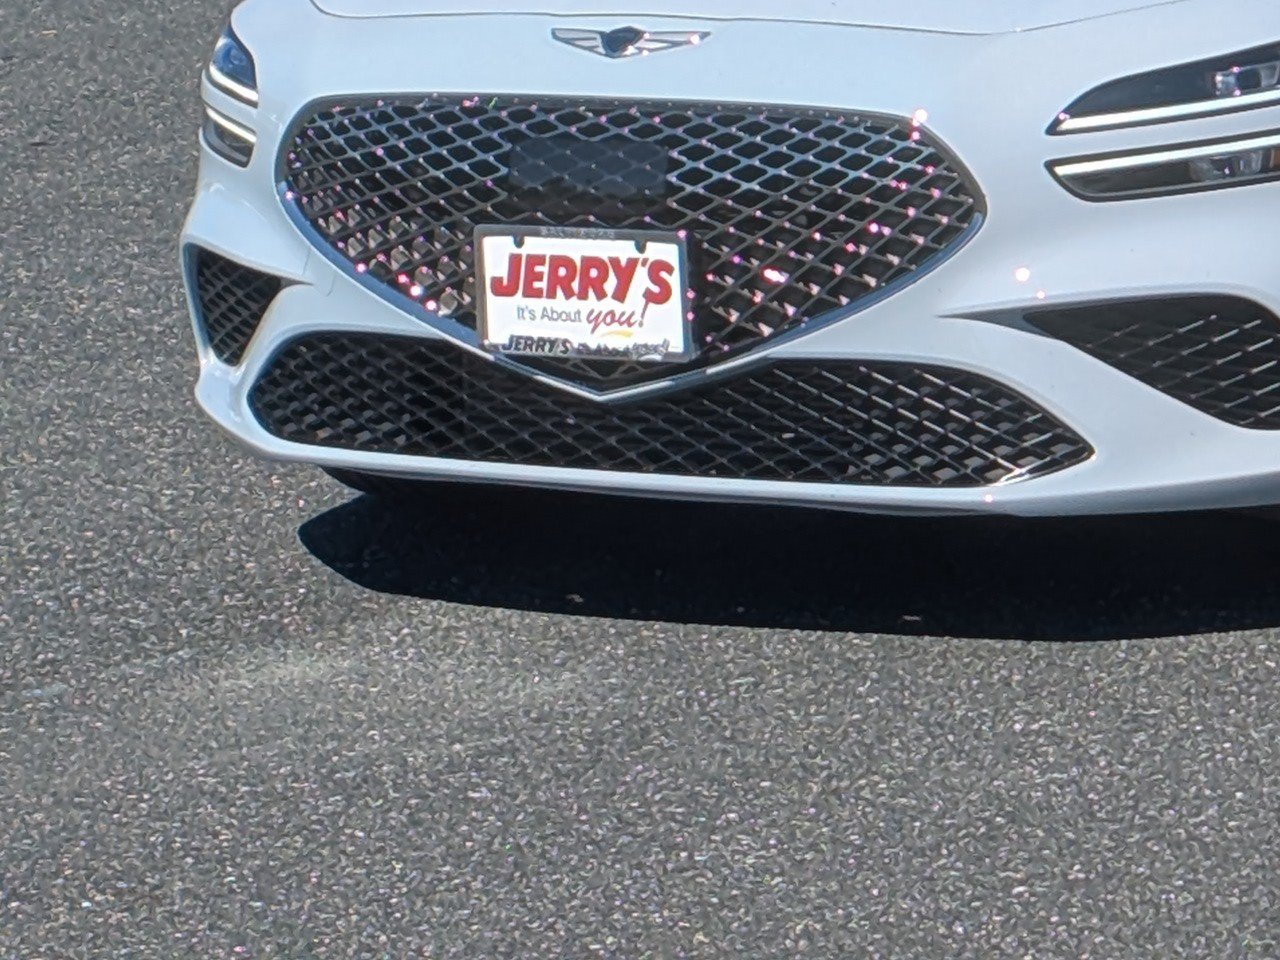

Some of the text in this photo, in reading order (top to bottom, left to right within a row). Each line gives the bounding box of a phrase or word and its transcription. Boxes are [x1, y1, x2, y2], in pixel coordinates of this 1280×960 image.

[490, 252, 675, 305] JERRY'S
[516, 300, 649, 334] It's About you!
